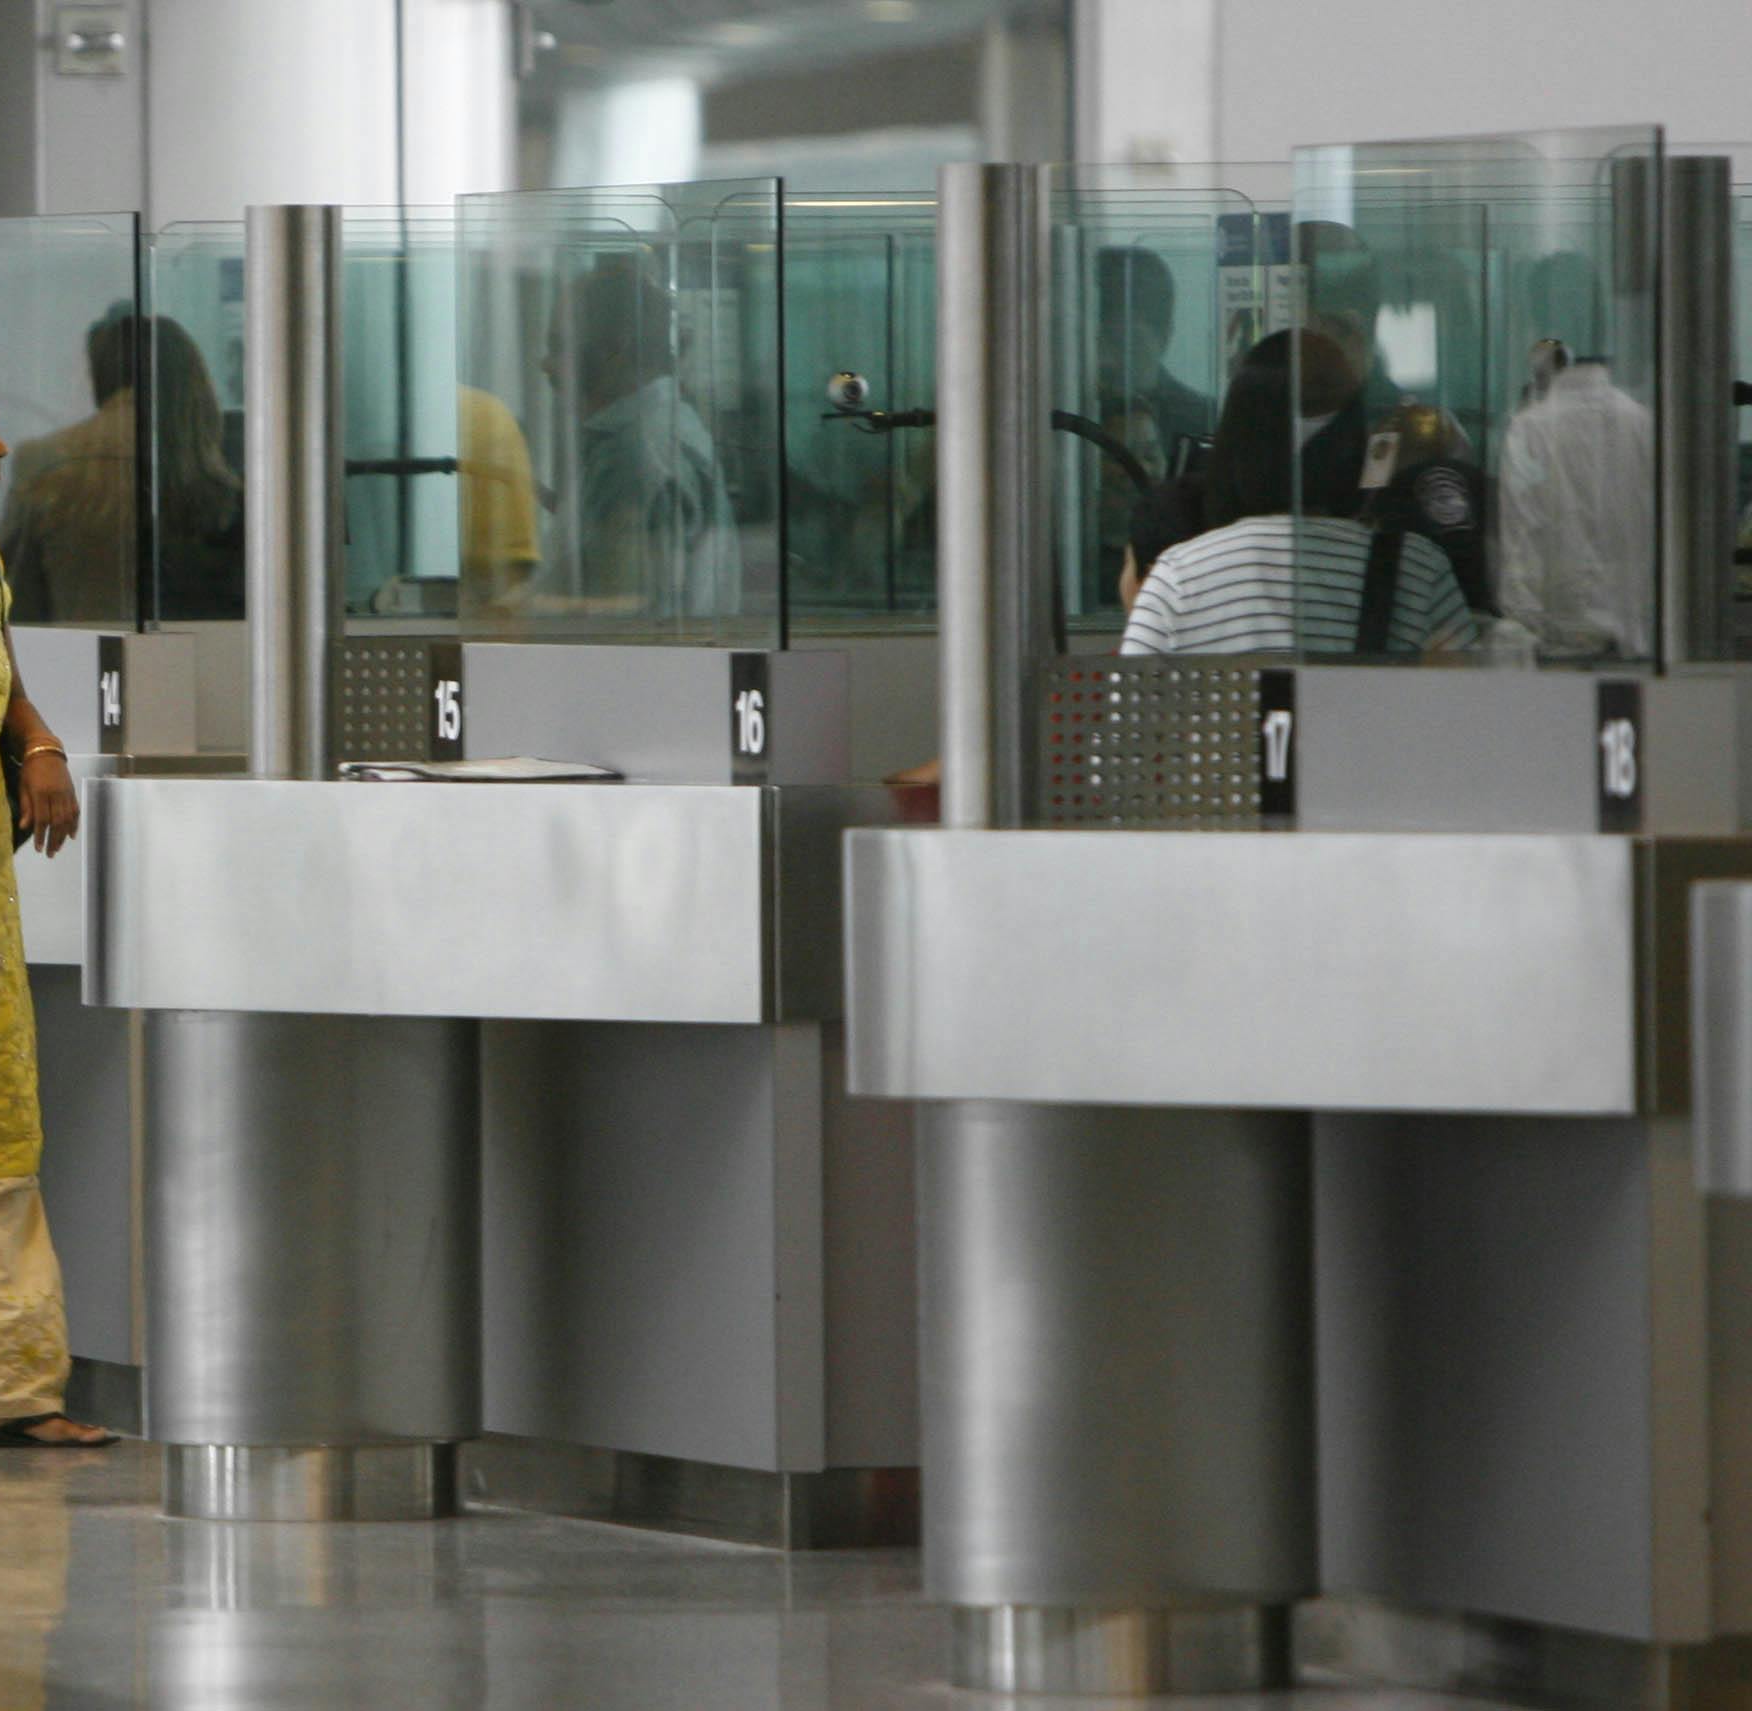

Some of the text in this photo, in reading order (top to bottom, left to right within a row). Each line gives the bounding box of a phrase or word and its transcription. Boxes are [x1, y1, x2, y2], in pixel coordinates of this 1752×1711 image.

[101, 671, 120, 726] 14
[435, 680, 461, 740] 15
[736, 689, 764, 753] 16
[1263, 710, 1292, 780] 17
[1602, 718, 1636, 798] 18
